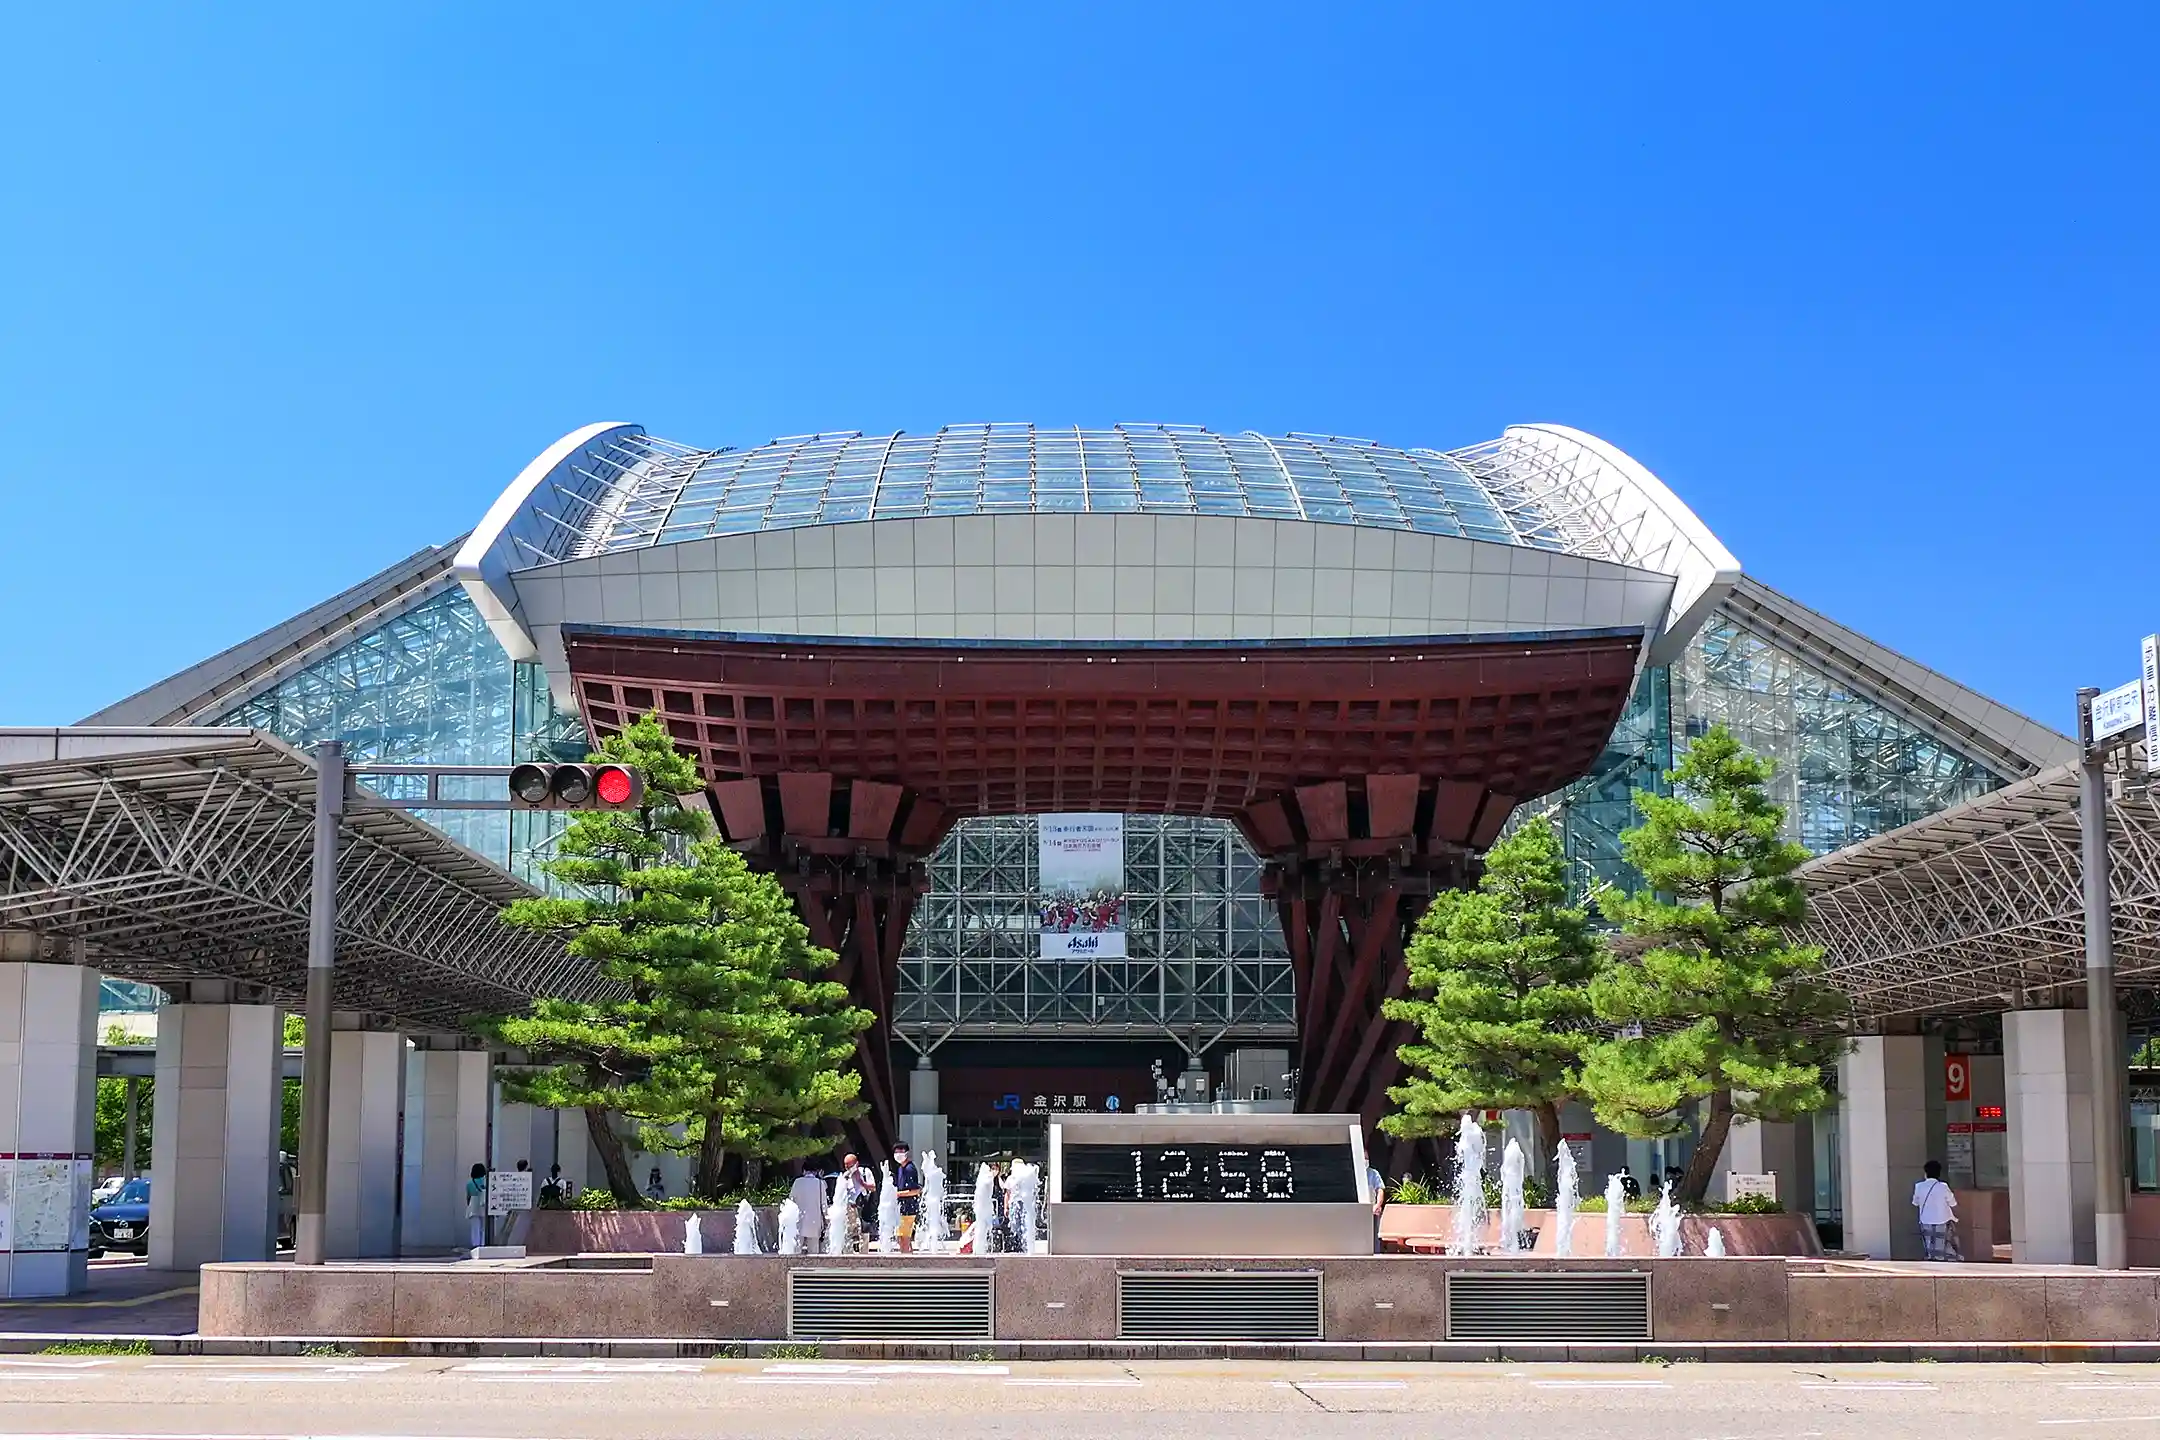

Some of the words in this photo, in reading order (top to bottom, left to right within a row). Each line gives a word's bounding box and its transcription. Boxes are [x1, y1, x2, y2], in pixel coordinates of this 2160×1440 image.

[1068, 935, 1099, 948] Asahi
[1948, 1063, 1964, 1093] 9
[993, 1094, 1020, 1110] JR
[1033, 1094, 1087, 1107] 金沢駅
[1131, 1150, 1295, 1199] 12:58
